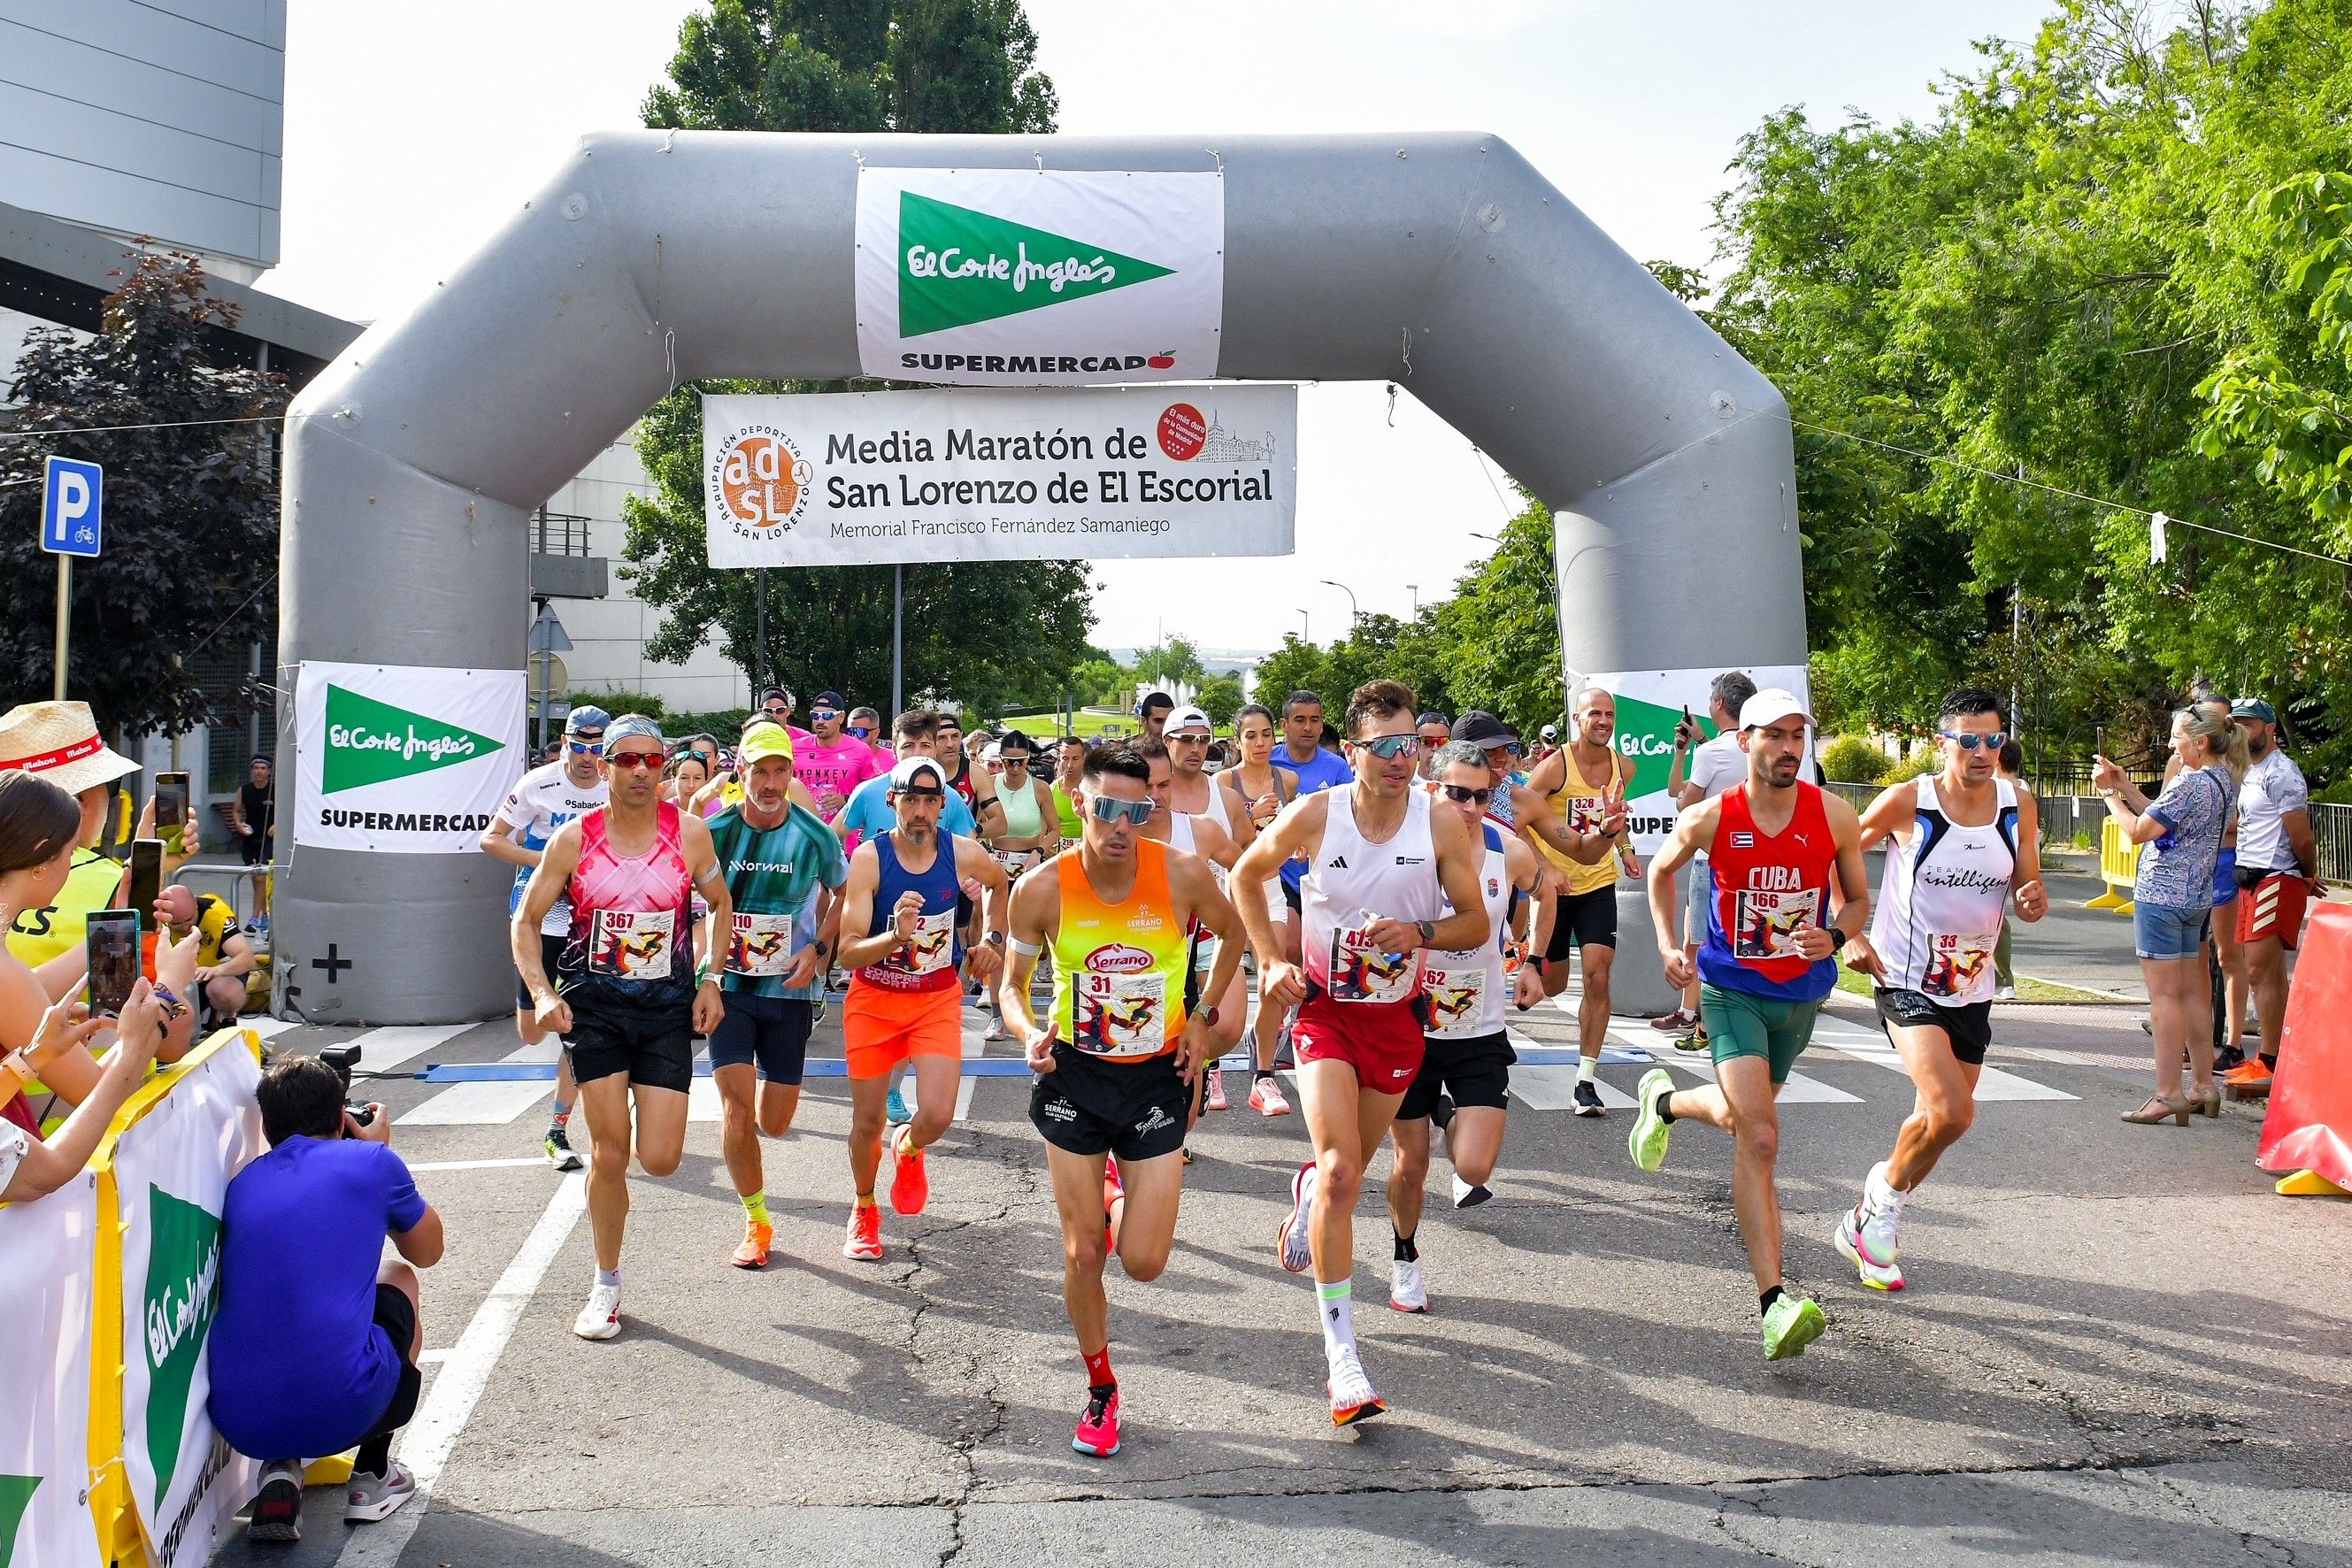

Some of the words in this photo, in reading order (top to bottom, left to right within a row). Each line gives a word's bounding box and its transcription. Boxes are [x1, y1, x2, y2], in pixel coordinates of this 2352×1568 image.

[907, 245, 939, 278] El
[940, 248, 1010, 281] Corte
[1013, 242, 1116, 293] Inglés
[1169, 408, 1177, 418] El
[1177, 413, 1190, 425] más
[1190, 420, 1205, 434] duro
[1174, 432, 1193, 446] Madrid
[1175, 423, 1203, 442] Comunidad
[826, 431, 934, 465] Media
[946, 428, 1094, 461] Maratón
[1104, 427, 1147, 460] de
[711, 434, 737, 520] AGRUPACIÓN
[741, 425, 801, 457] DEPORTIVA
[827, 475, 891, 509] San
[900, 473, 1037, 506] Lorenzo
[1047, 472, 1088, 504] de
[1098, 471, 1128, 503] El
[1138, 469, 1272, 503] Escorial
[55, 470, 90, 542] P
[733, 522, 760, 541] SAN
[766, 487, 810, 540] LORENZO
[830, 520, 906, 538] Memorial
[912, 518, 986, 535] Francisco
[991, 517, 1075, 534] Fernández
[1081, 516, 1171, 536] Samaniego
[66, 744, 92, 758] Mahou
[329, 724, 350, 748] El
[350, 726, 402, 752] Corte
[403, 724, 475, 762] Inglés
[1620, 733, 1641, 756] El
[1641, 734, 1691, 756] Cor
[22, 757, 57, 771] Mahou
[1575, 798, 1595, 809] 328
[1749, 865, 1802, 890] CUBA
[1926, 865, 1964, 873] TEAM
[1750, 892, 1779, 909] 166
[605, 911, 634, 929] 367
[1126, 918, 1162, 927] SERRANO
[1345, 930, 1375, 948] 473
[1940, 934, 1958, 949] 33
[1092, 955, 1149, 969] Serrano
[1091, 975, 1111, 993] 31
[1044, 1103, 1077, 1118] SERRANO
